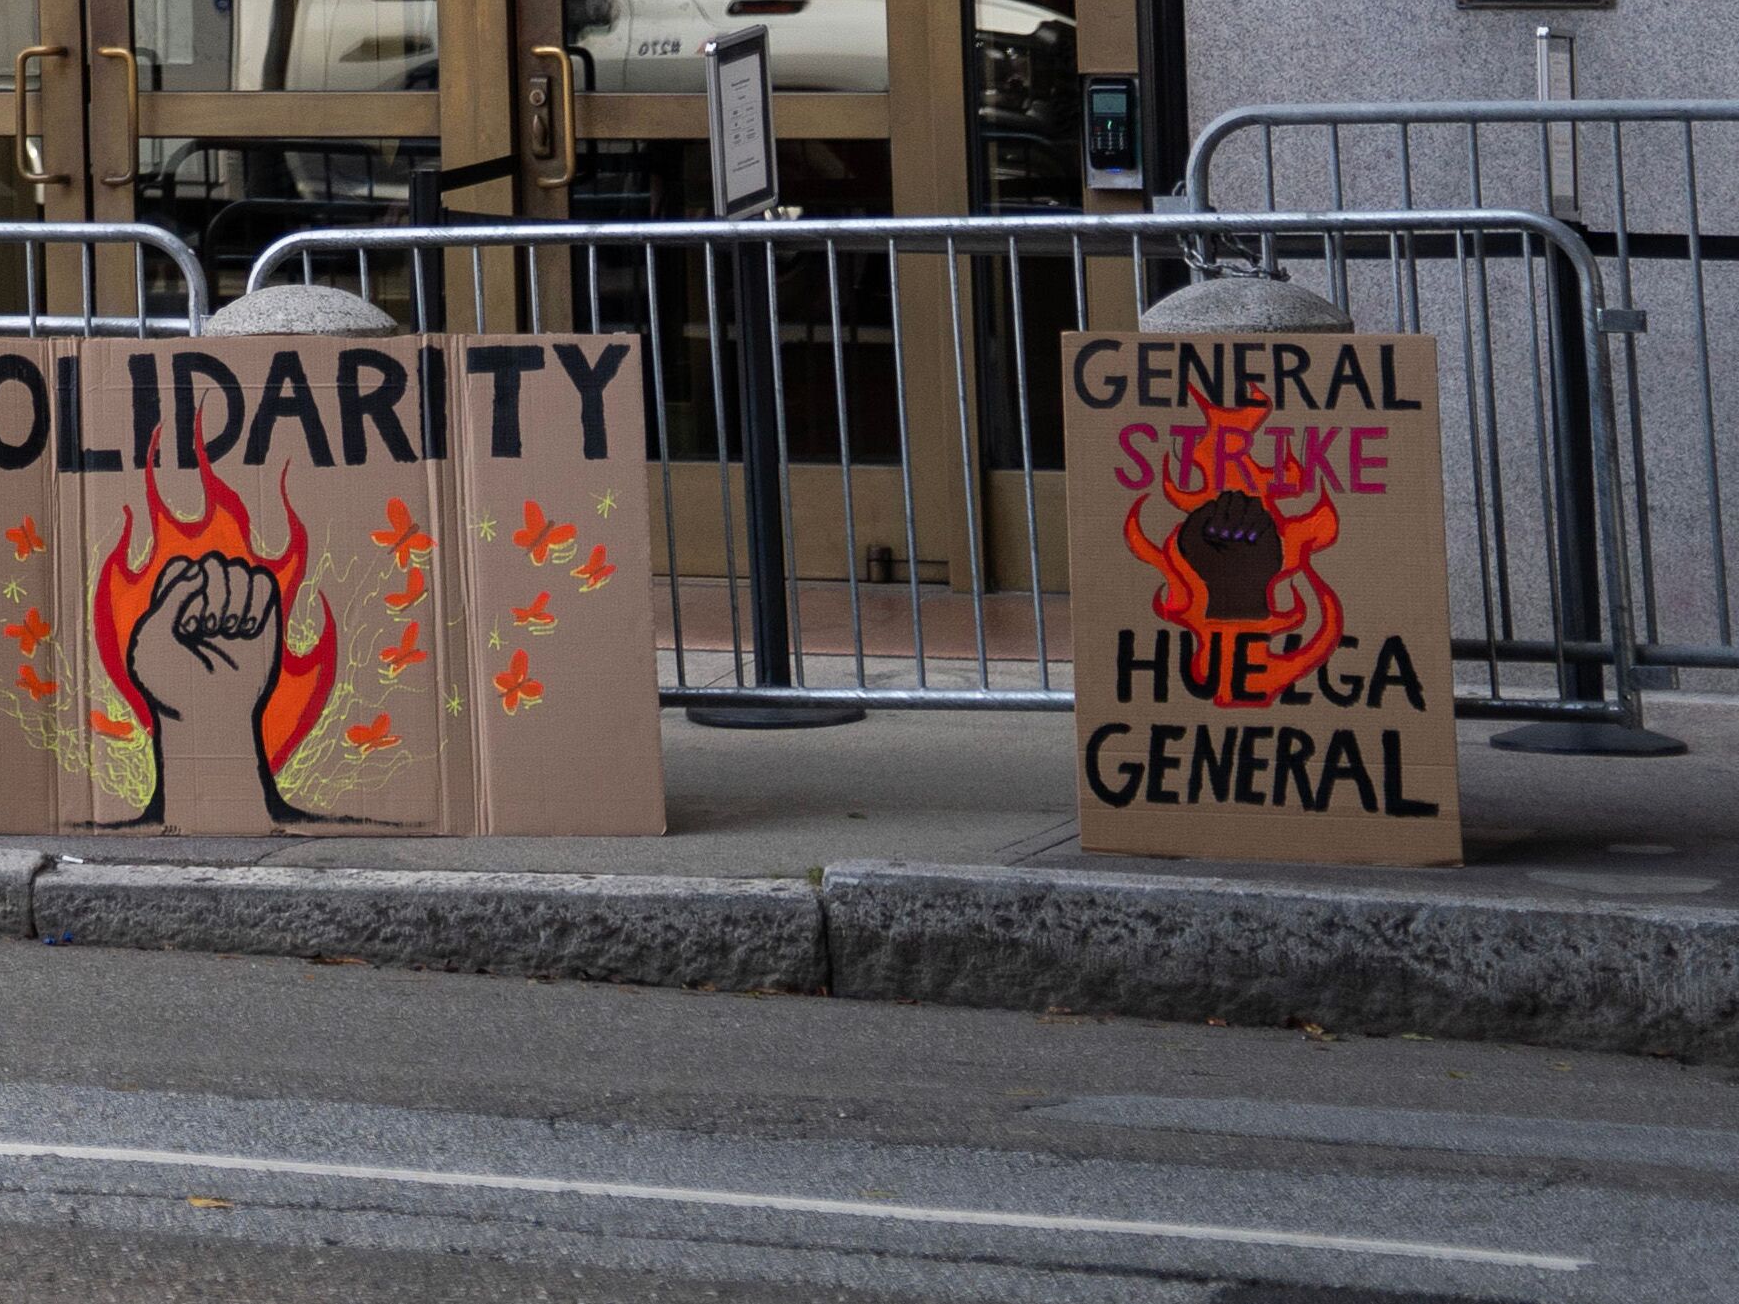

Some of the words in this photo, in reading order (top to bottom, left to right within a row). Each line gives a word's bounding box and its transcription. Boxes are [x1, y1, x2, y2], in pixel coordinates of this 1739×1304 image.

[1072, 339, 1422, 411] GENERAL
[1114, 423, 1390, 495] STRIKE
[1116, 629, 1427, 711] HUELGA
[1084, 723, 1440, 818] GENERAL
